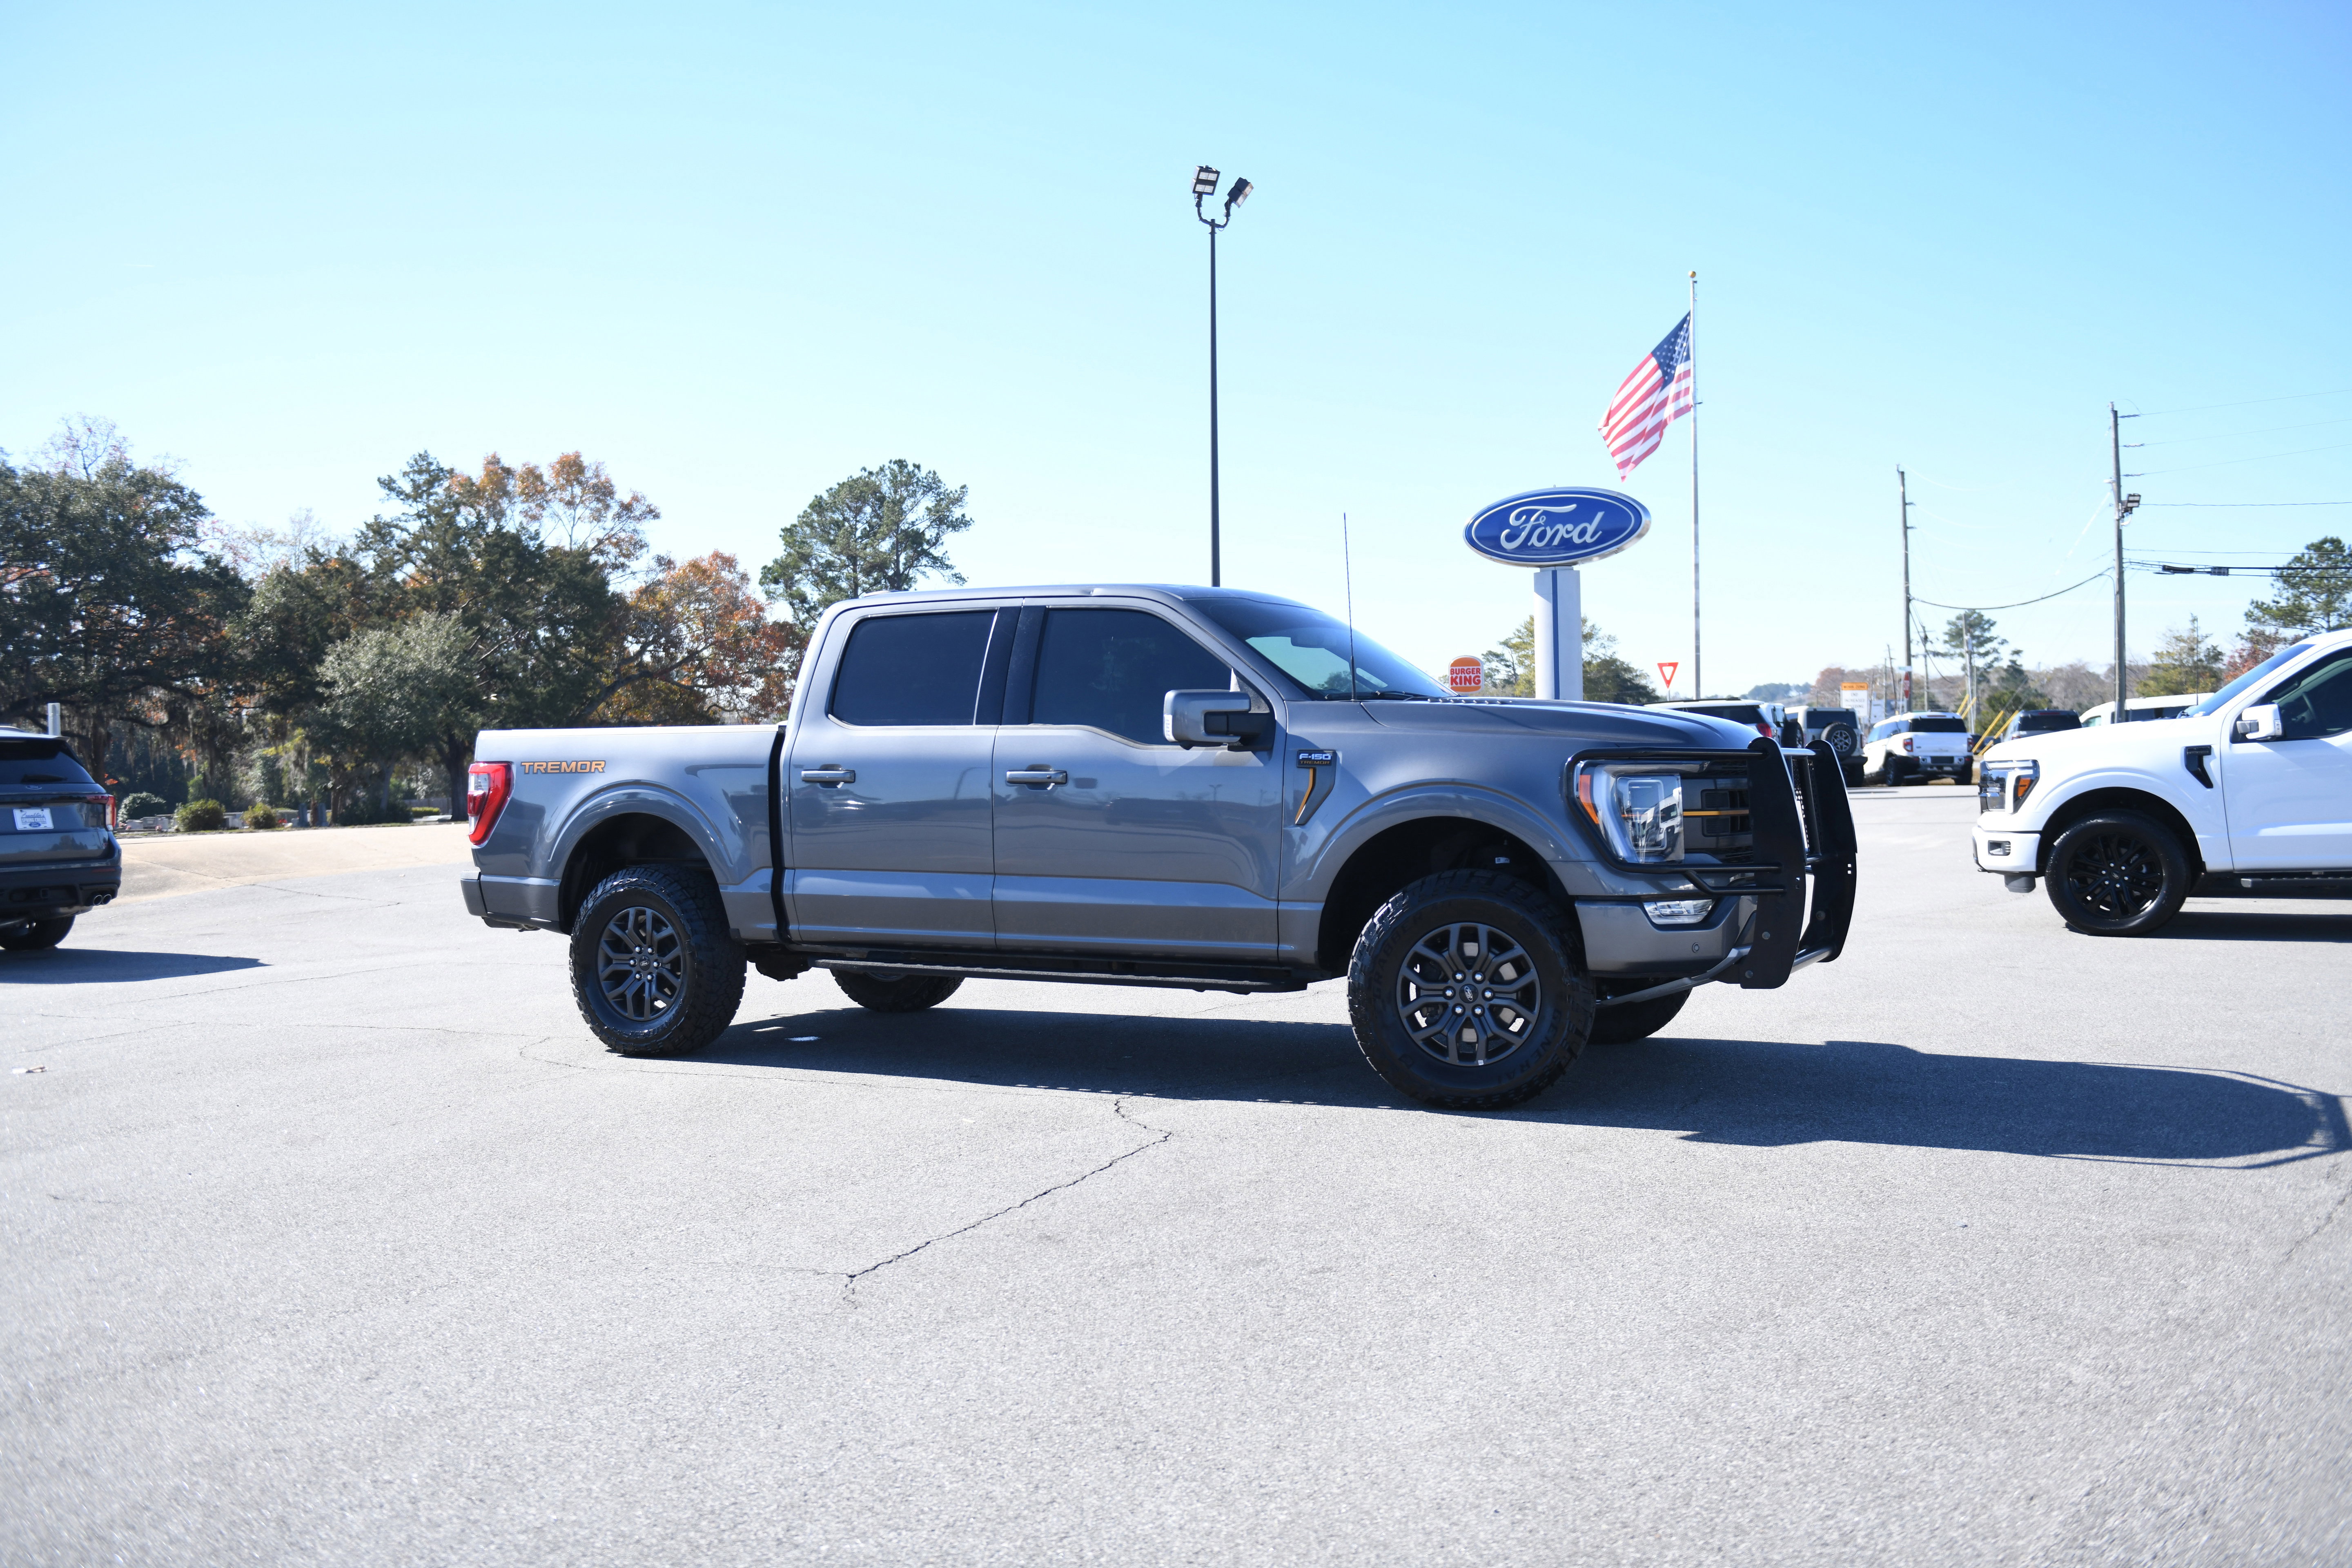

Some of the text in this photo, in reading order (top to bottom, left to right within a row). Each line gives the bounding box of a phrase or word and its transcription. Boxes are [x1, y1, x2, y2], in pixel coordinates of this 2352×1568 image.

[1500, 503, 1605, 550] Ford
[1450, 675, 1481, 686] KING
[521, 760, 606, 774] TREMOR
